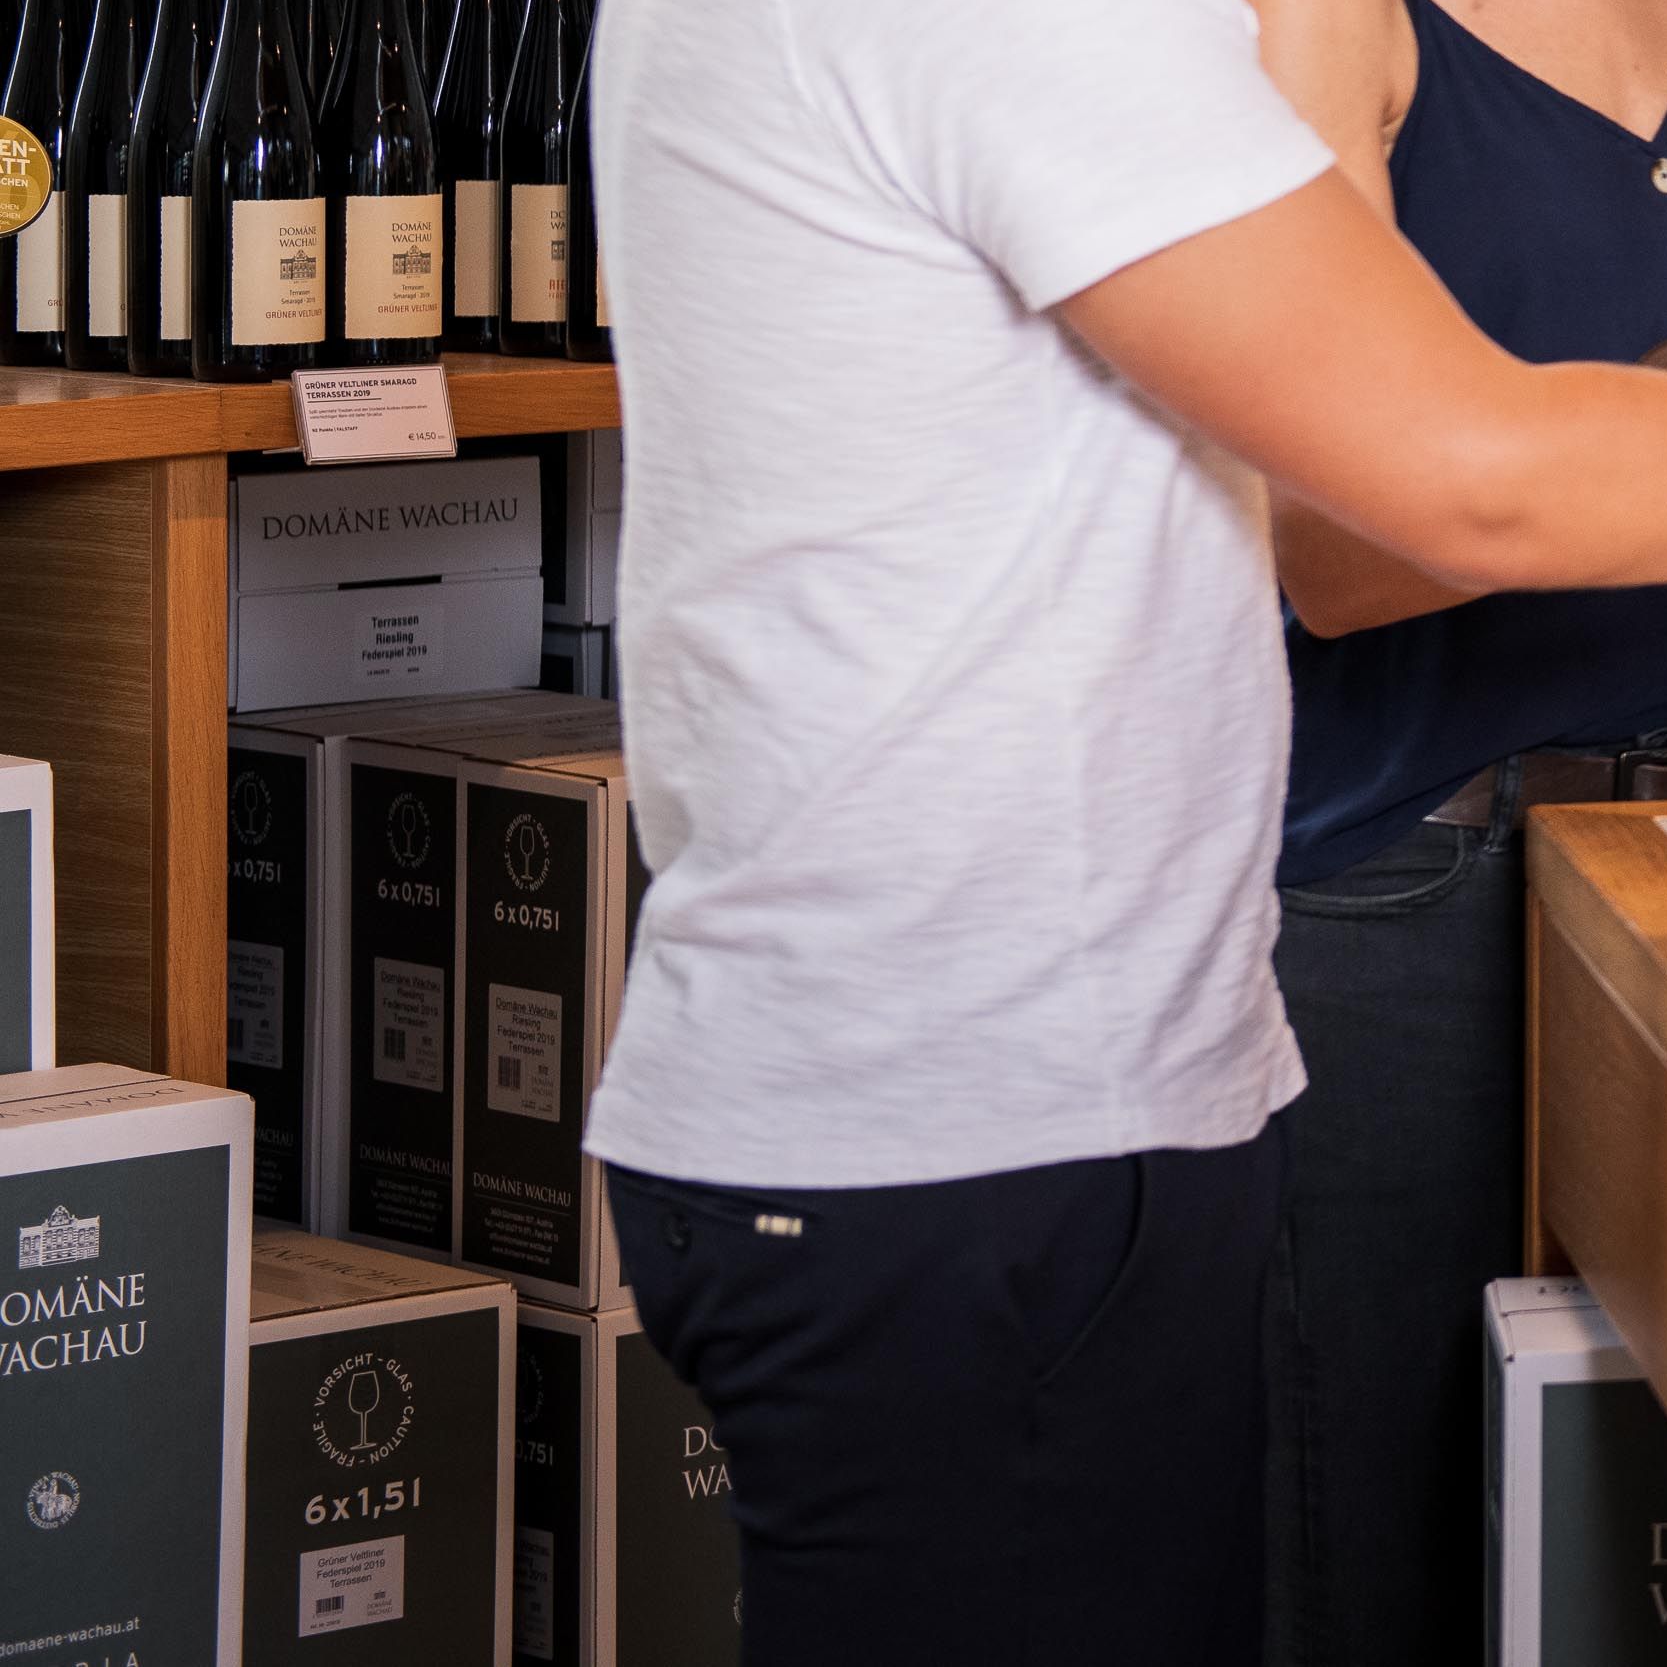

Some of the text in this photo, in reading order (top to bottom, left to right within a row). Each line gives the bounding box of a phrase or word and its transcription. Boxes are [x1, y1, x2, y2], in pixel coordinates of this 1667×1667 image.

[0, 177, 28, 188] CHEN
[279, 225, 317, 236] DOMÄNE
[392, 222, 432, 232] DOMÄNE
[279, 238, 317, 248] WACHAU
[392, 233, 433, 243] WACHAU
[265, 309, 296, 319] GRÜNER
[378, 304, 409, 314] GRÜNER
[305, 378, 417, 390] GRÜNER VELTLINER SMARAGD
[306, 389, 371, 399] TERRASSEN 2019
[262, 497, 519, 541] DOMÄNE WACHAU
[371, 614, 420, 628] Terrassen
[375, 630, 415, 646] Riesling
[361, 645, 428, 662] Federspiel 2019
[496, 997, 557, 1020] Domäne Wachau
[512, 1014, 541, 1031] Riesling
[497, 1025, 555, 1046] Federspiel 2019
[509, 1041, 544, 1057] Terrassen
[360, 1142, 408, 1167] DOMÄNE
[472, 1171, 572, 1207] DOMÄNE WACHAU
[0, 1273, 145, 1326] OMÄNE
[0, 1321, 147, 1376] ACHAU
[313, 1352, 415, 1467] VORSICHT GLAS CAUTION FRAGILE
[318, 1548, 385, 1568] Grüner Veltliner
[317, 1558, 386, 1579] Federspiel 2019
[330, 1574, 372, 1589] Terrassen
